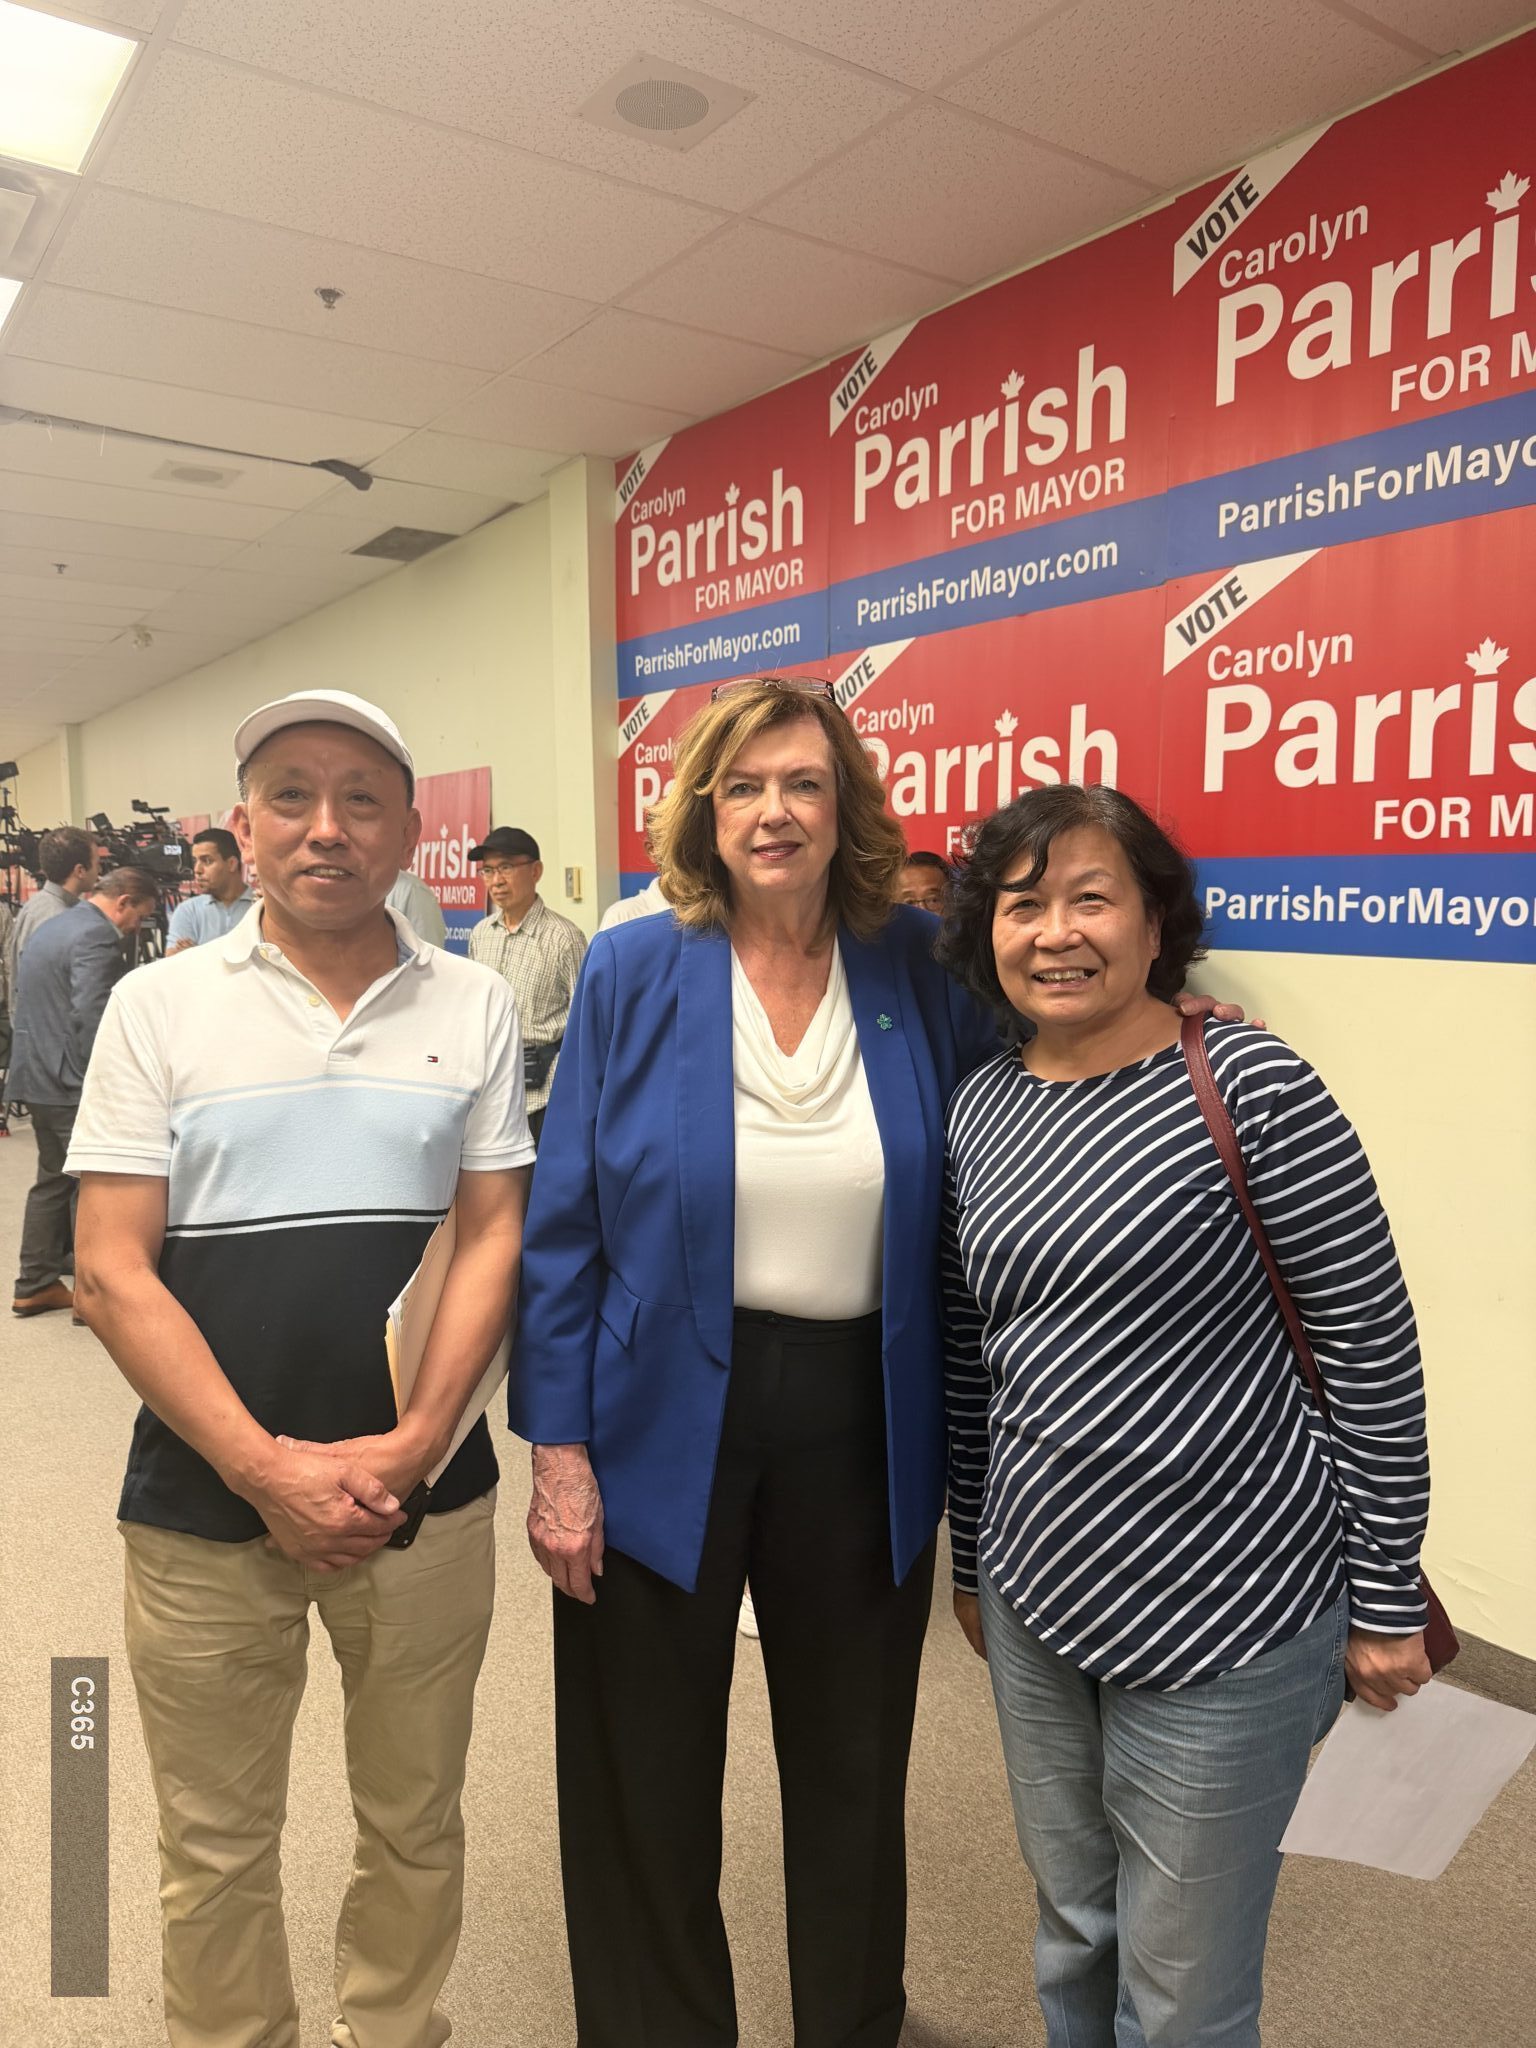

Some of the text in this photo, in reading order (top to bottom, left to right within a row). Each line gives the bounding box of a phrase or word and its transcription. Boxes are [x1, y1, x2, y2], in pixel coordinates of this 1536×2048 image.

[1187, 174, 1260, 260] VOTE
[1218, 204, 1369, 289] Carolyn
[836, 351, 878, 411] VOTE
[1391, 344, 1491, 412] FOR
[854, 344, 1127, 525] Parrish
[855, 382, 938, 435] Carolyn
[619, 458, 646, 503] VOTE
[631, 487, 686, 524] Carolyn
[951, 457, 1126, 539] FOR MAYOR
[631, 468, 804, 597] Parrish
[695, 558, 804, 613] FOR MAYOR
[857, 541, 1119, 626] ParrishForMayor.com
[1176, 575, 1248, 648] VOTE
[635, 622, 801, 677] ParrishForMayor.com
[1207, 631, 1354, 681] Carolyn
[836, 655, 876, 708] VOTE
[622, 701, 650, 742] VOTE
[853, 698, 935, 735] Carolyn
[1374, 796, 1471, 840] FOR
[442, 884, 477, 905] MAYOR
